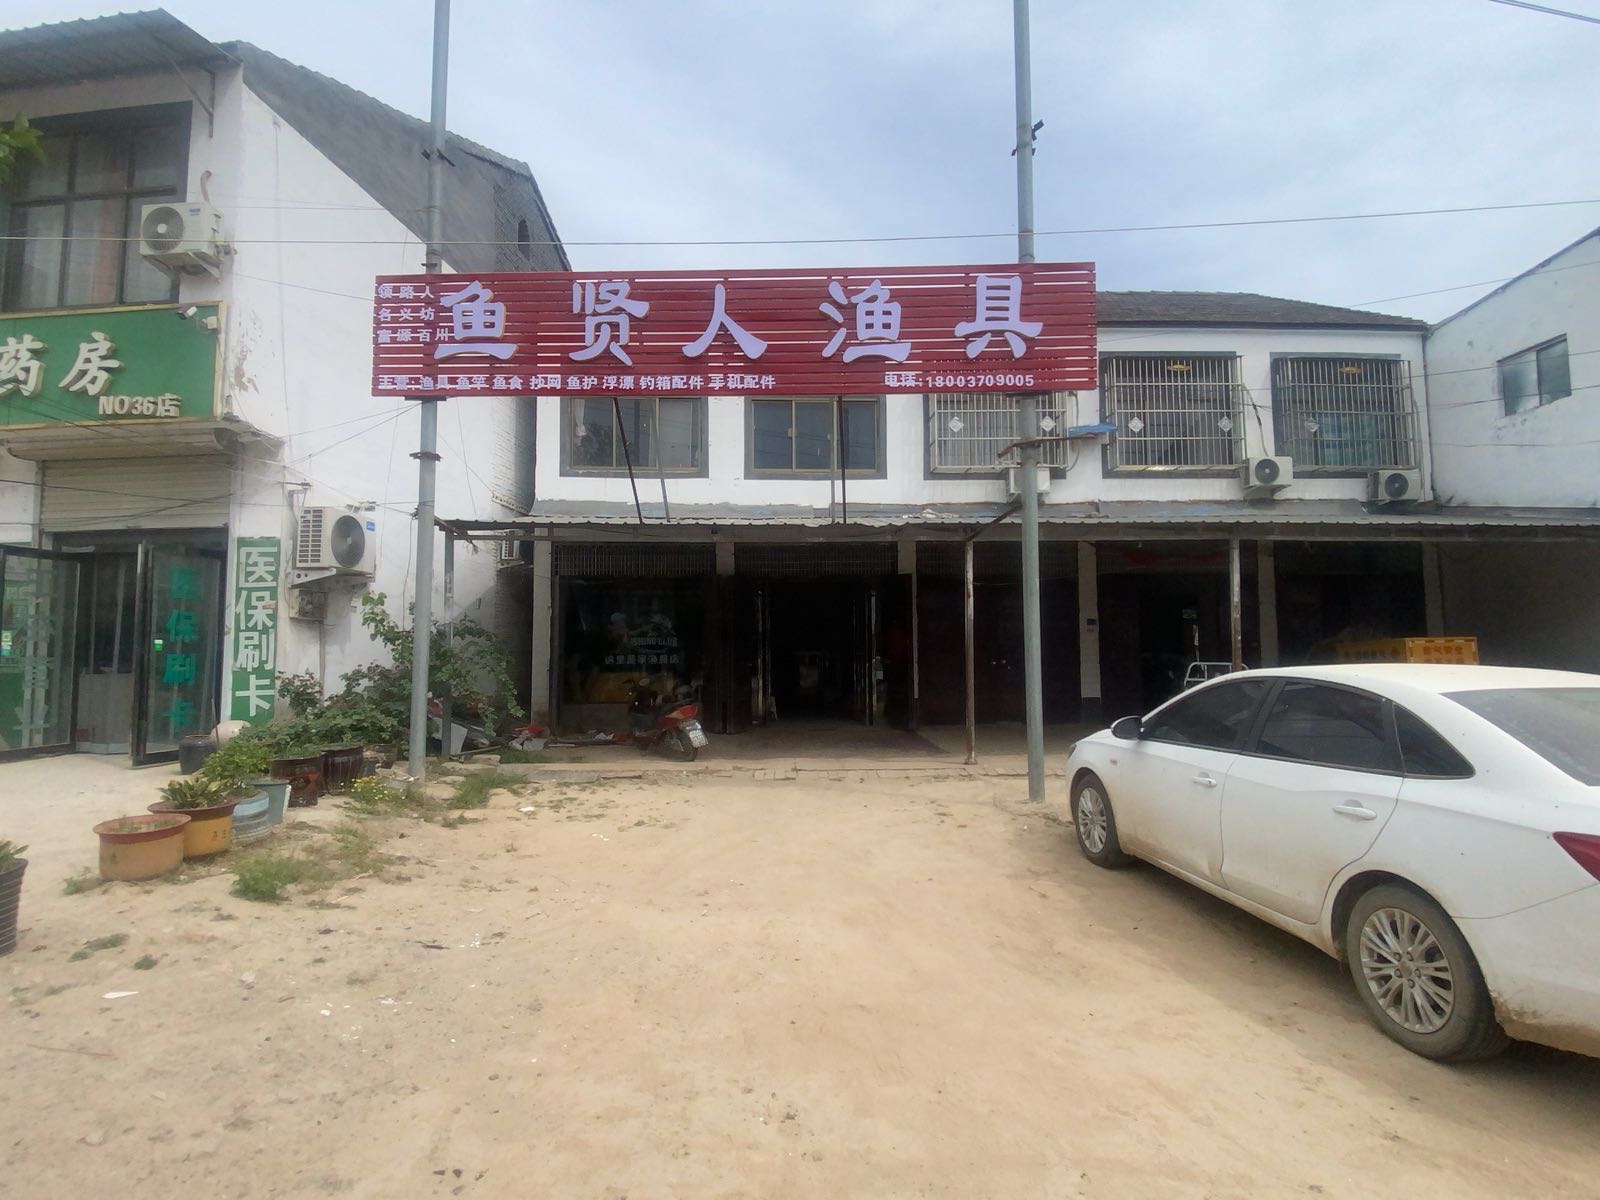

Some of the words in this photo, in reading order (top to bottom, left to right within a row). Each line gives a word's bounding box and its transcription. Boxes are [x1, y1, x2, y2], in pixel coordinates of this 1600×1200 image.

[377, 284, 435, 299] 领路人
[433, 273, 1044, 367] 鱼贤人渔具
[0, 331, 122, 397] 药房
[492, 376, 524, 390] 鱼食
[566, 375, 598, 390] 鱼护
[639, 375, 704, 391] 钓箱配件
[708, 374, 777, 390] 手机配件
[234, 545, 279, 717] 医保刷卡
